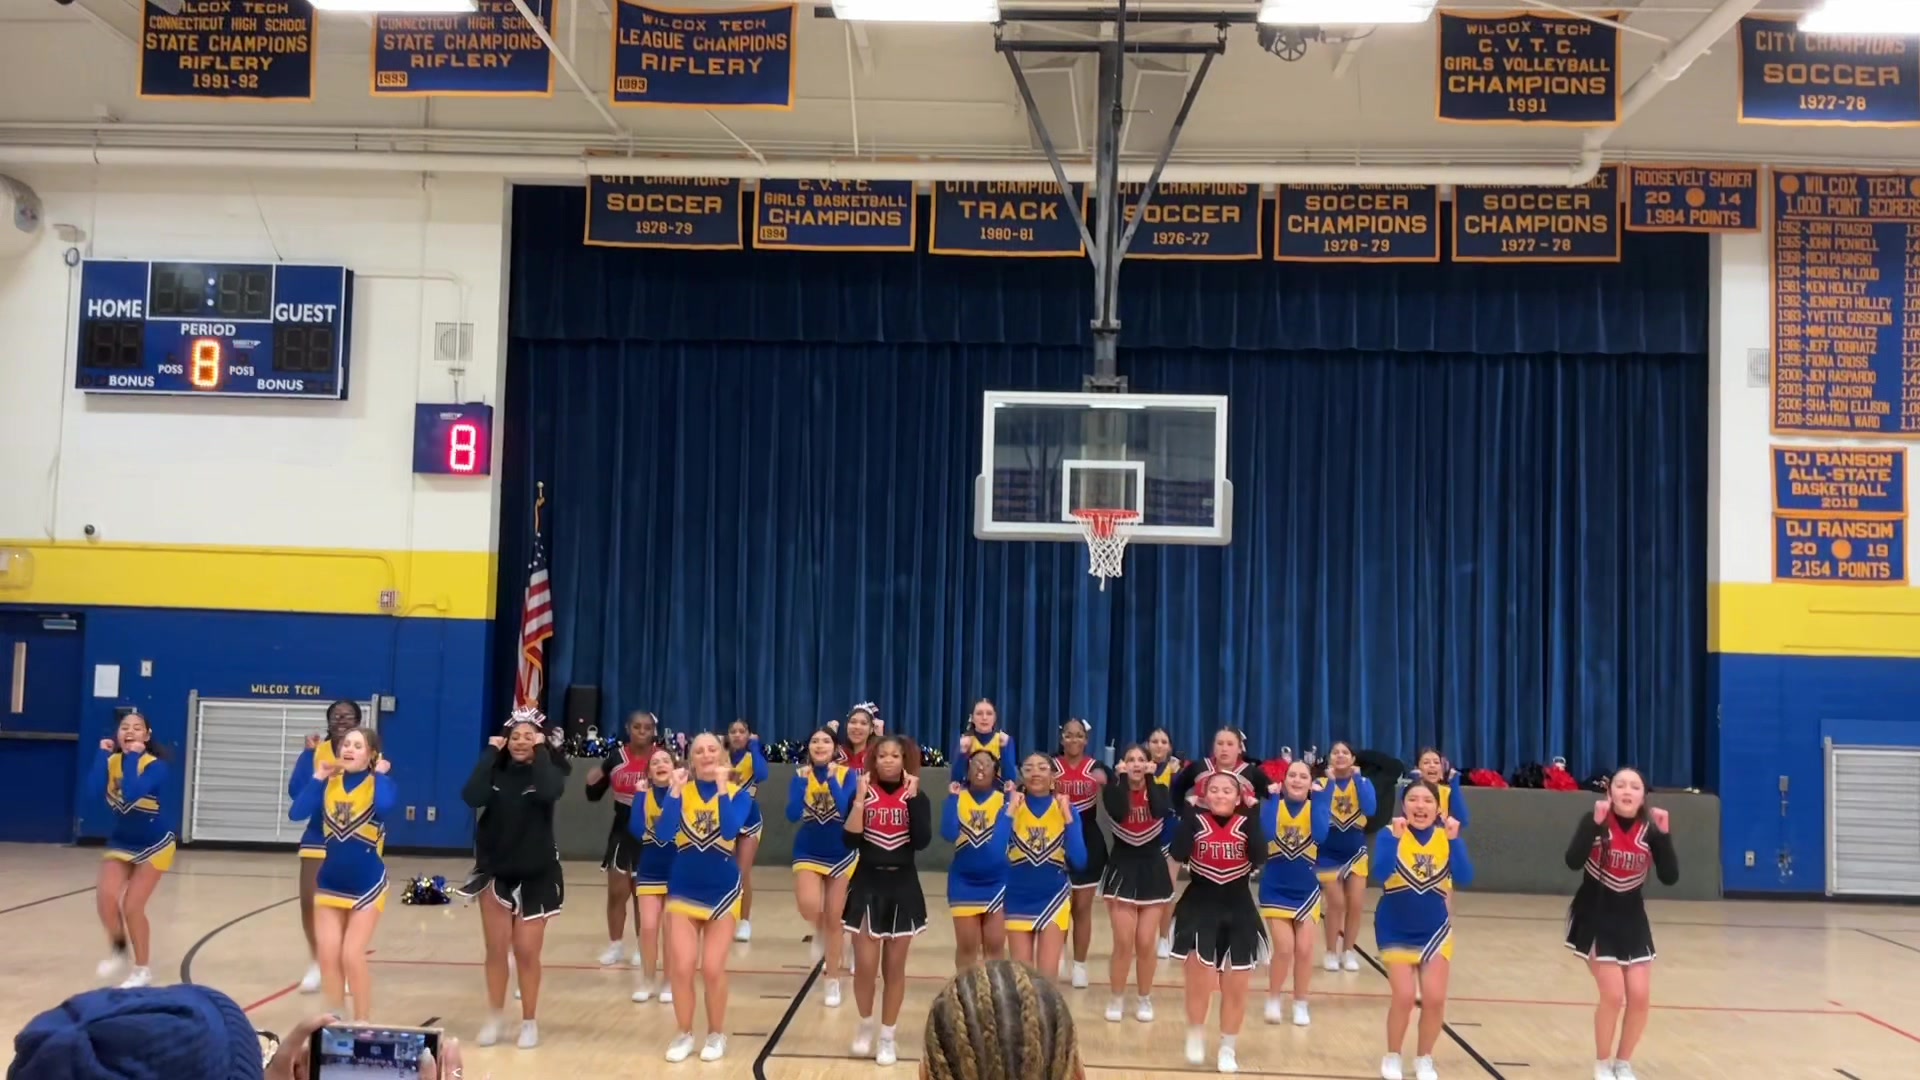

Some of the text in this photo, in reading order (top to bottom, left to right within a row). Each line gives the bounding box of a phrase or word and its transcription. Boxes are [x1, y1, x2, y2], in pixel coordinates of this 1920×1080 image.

[179, 1, 289, 14] ILCOX TECH
[479, 2, 519, 13] TEC
[149, 15, 307, 32] CONNECTICUT HIGH SCHOOL
[380, 16, 459, 30] CONNECTICUT
[467, 16, 495, 30] HIGH
[642, 13, 767, 32] WILCOX TECH
[1466, 21, 1592, 35] WILCOX TECH
[145, 33, 308, 53] STATE CHAMPIONS
[383, 33, 543, 51] STATE CHAMPIONS
[619, 27, 788, 52] LEAGUE CHAMPIONS
[1755, 30, 1906, 54] CITY CHAMPIONS
[178, 55, 273, 71] RIFLERY
[410, 53, 513, 68] RIFLERY
[641, 52, 763, 75] RIFLERY
[1444, 56, 1610, 72] GIRLS VOLLEYBALL
[192, 73, 259, 89] 1991-92
[1763, 63, 1900, 86] SOCCER
[1448, 76, 1606, 94] CHAMPIONS
[1507, 97, 1547, 113] 1991
[1799, 94, 1867, 111] 1977-78
[1634, 170, 1706, 187] ROOSEVELT
[1805, 176, 1906, 196] WILCOX TECH
[945, 180, 1073, 195] CITY CHAMPION
[1117, 182, 1248, 196] CIT CHAMPIONS
[606, 192, 722, 214] SOCCER
[764, 192, 907, 208] GIRLS BASKETBALL
[1305, 194, 1409, 211] SOCCER
[1483, 193, 1590, 211] SOCCER
[1644, 191, 1671, 204] 20
[1719, 192, 1741, 206] 14
[958, 200, 1058, 220] TRACK
[1123, 204, 1240, 224] SOCCER
[1827, 197, 1862, 216] POINT
[1868, 198, 1920, 217] SCORERS
[768, 208, 902, 226] CHAMPIONS
[1287, 214, 1428, 235] CHAMPIONS
[1464, 214, 1609, 234] CHAMPIONS
[1689, 209, 1741, 226] POINTS
[635, 220, 693, 235] 1978-79
[980, 226, 1034, 241] 1980-81
[1153, 231, 1210, 245] 1976-77
[1828, 281, 1867, 295] HOLLEY
[88, 298, 142, 319] HOME
[1854, 296, 1892, 310] HOLLEY
[275, 303, 336, 323] GUEST
[180, 322, 236, 336] PERIOD
[158, 363, 183, 375] POSS
[192, 338, 220, 387] 8
[109, 375, 155, 387] BONUS
[257, 379, 304, 391] BONUS
[1828, 384, 1873, 398] JACKSON
[1850, 400, 1890, 415] ELLISON
[1854, 415, 1880, 428] WARD
[450, 424, 476, 471] 8
[1784, 452, 1893, 467] DJ RANSOM
[1788, 468, 1891, 482] ALL-STATE
[1791, 482, 1887, 496] BASKETBALL
[1785, 520, 1894, 538] DJ RANSOM
[1790, 542, 1817, 555] 20
[1866, 543, 1889, 557] 19
[1791, 560, 1890, 579] 2,154 POINTS
[251, 684, 320, 695] WILCOX TECH
[1198, 841, 1248, 860] PTHS
